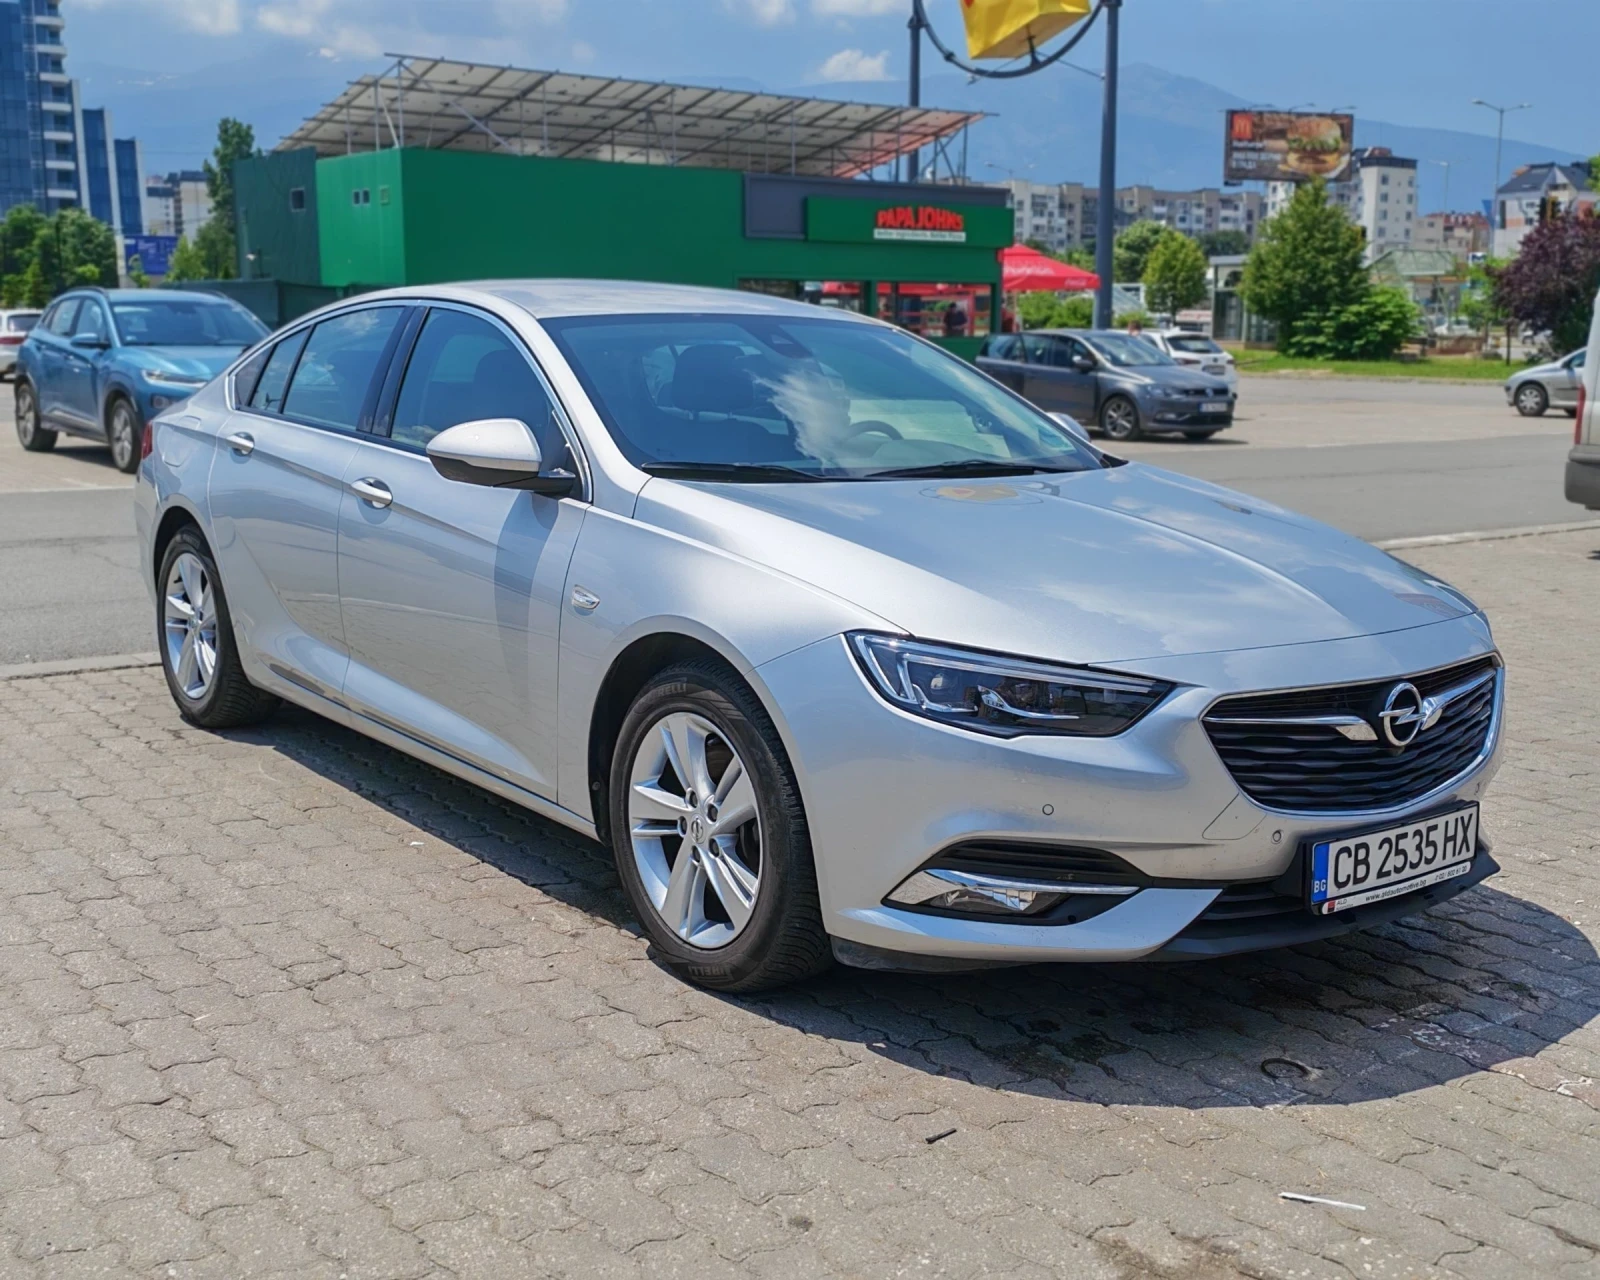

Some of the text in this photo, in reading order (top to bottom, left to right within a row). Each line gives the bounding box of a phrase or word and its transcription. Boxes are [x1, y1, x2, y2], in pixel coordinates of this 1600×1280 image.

[877, 206, 964, 231] PAPA JOHNS
[1333, 813, 1473, 889] CB 2535 HX
[1313, 879, 1327, 894] BG
